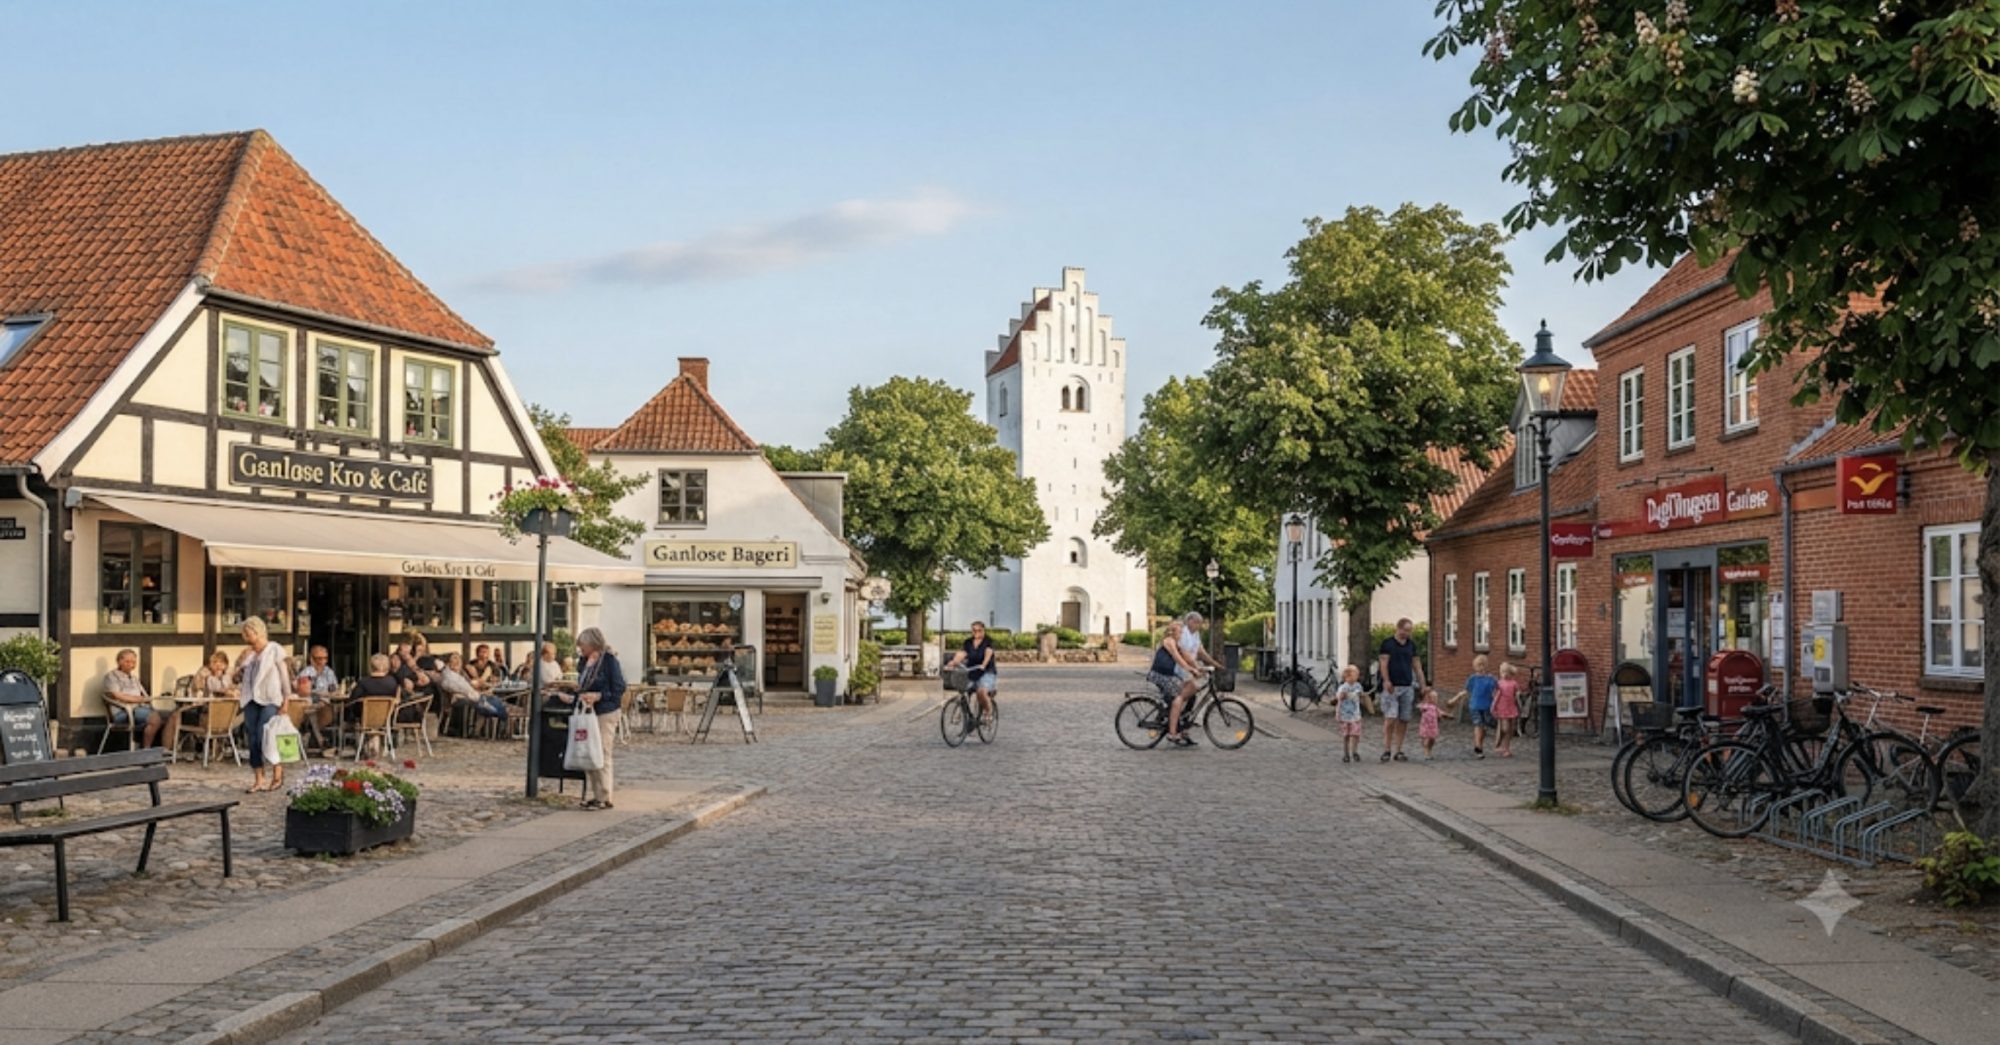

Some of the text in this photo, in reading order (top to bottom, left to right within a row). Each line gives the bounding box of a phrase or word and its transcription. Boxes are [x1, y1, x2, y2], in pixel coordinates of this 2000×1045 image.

[329, 461, 364, 488] Kro
[369, 467, 384, 489] &
[388, 470, 427, 494] Café
[732, 546, 789, 566] Bageri
